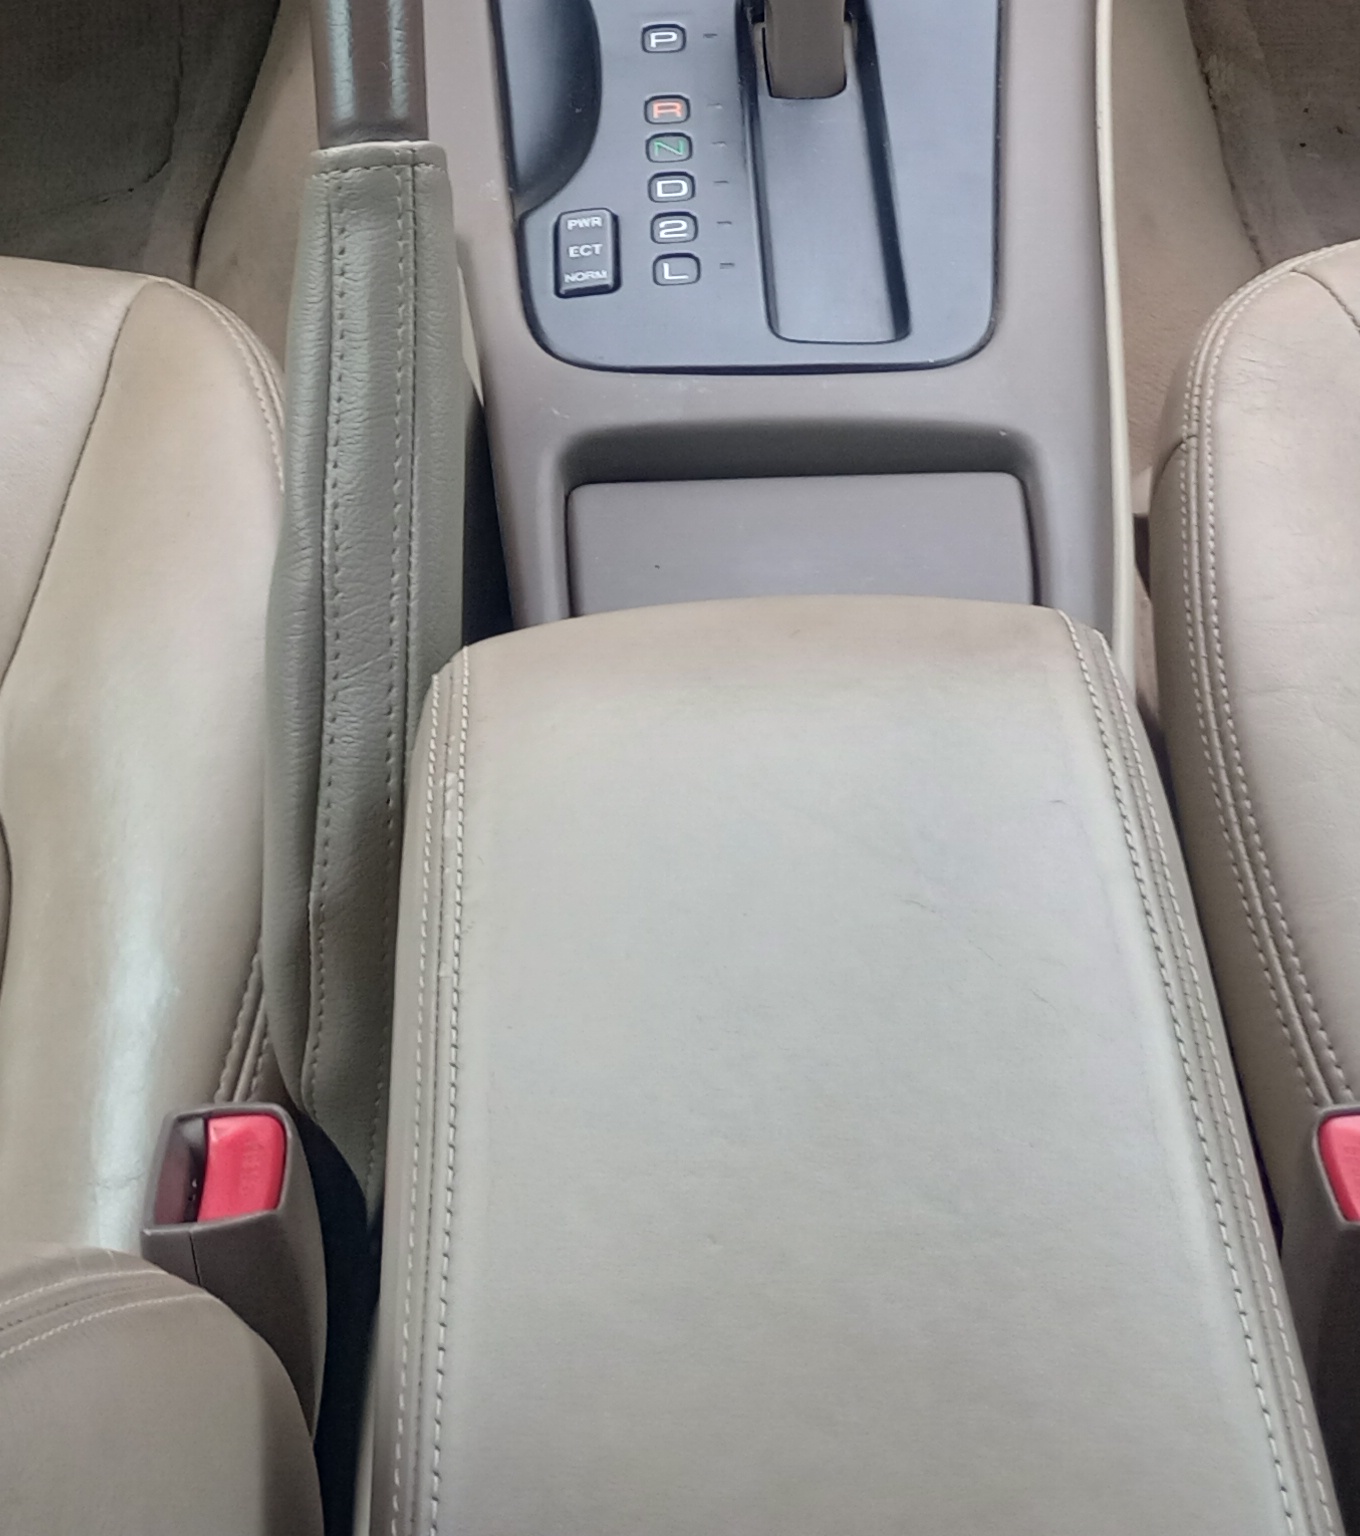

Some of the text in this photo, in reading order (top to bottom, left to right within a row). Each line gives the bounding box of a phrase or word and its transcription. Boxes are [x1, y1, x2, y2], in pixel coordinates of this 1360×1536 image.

[650, 31, 678, 48] P
[653, 102, 682, 119] R
[654, 139, 684, 157] N
[656, 179, 688, 197] D
[566, 216, 603, 230] PWR
[658, 219, 689, 238] 2
[568, 243, 603, 258] ECT
[564, 269, 608, 283] NORM
[663, 262, 689, 279] L
